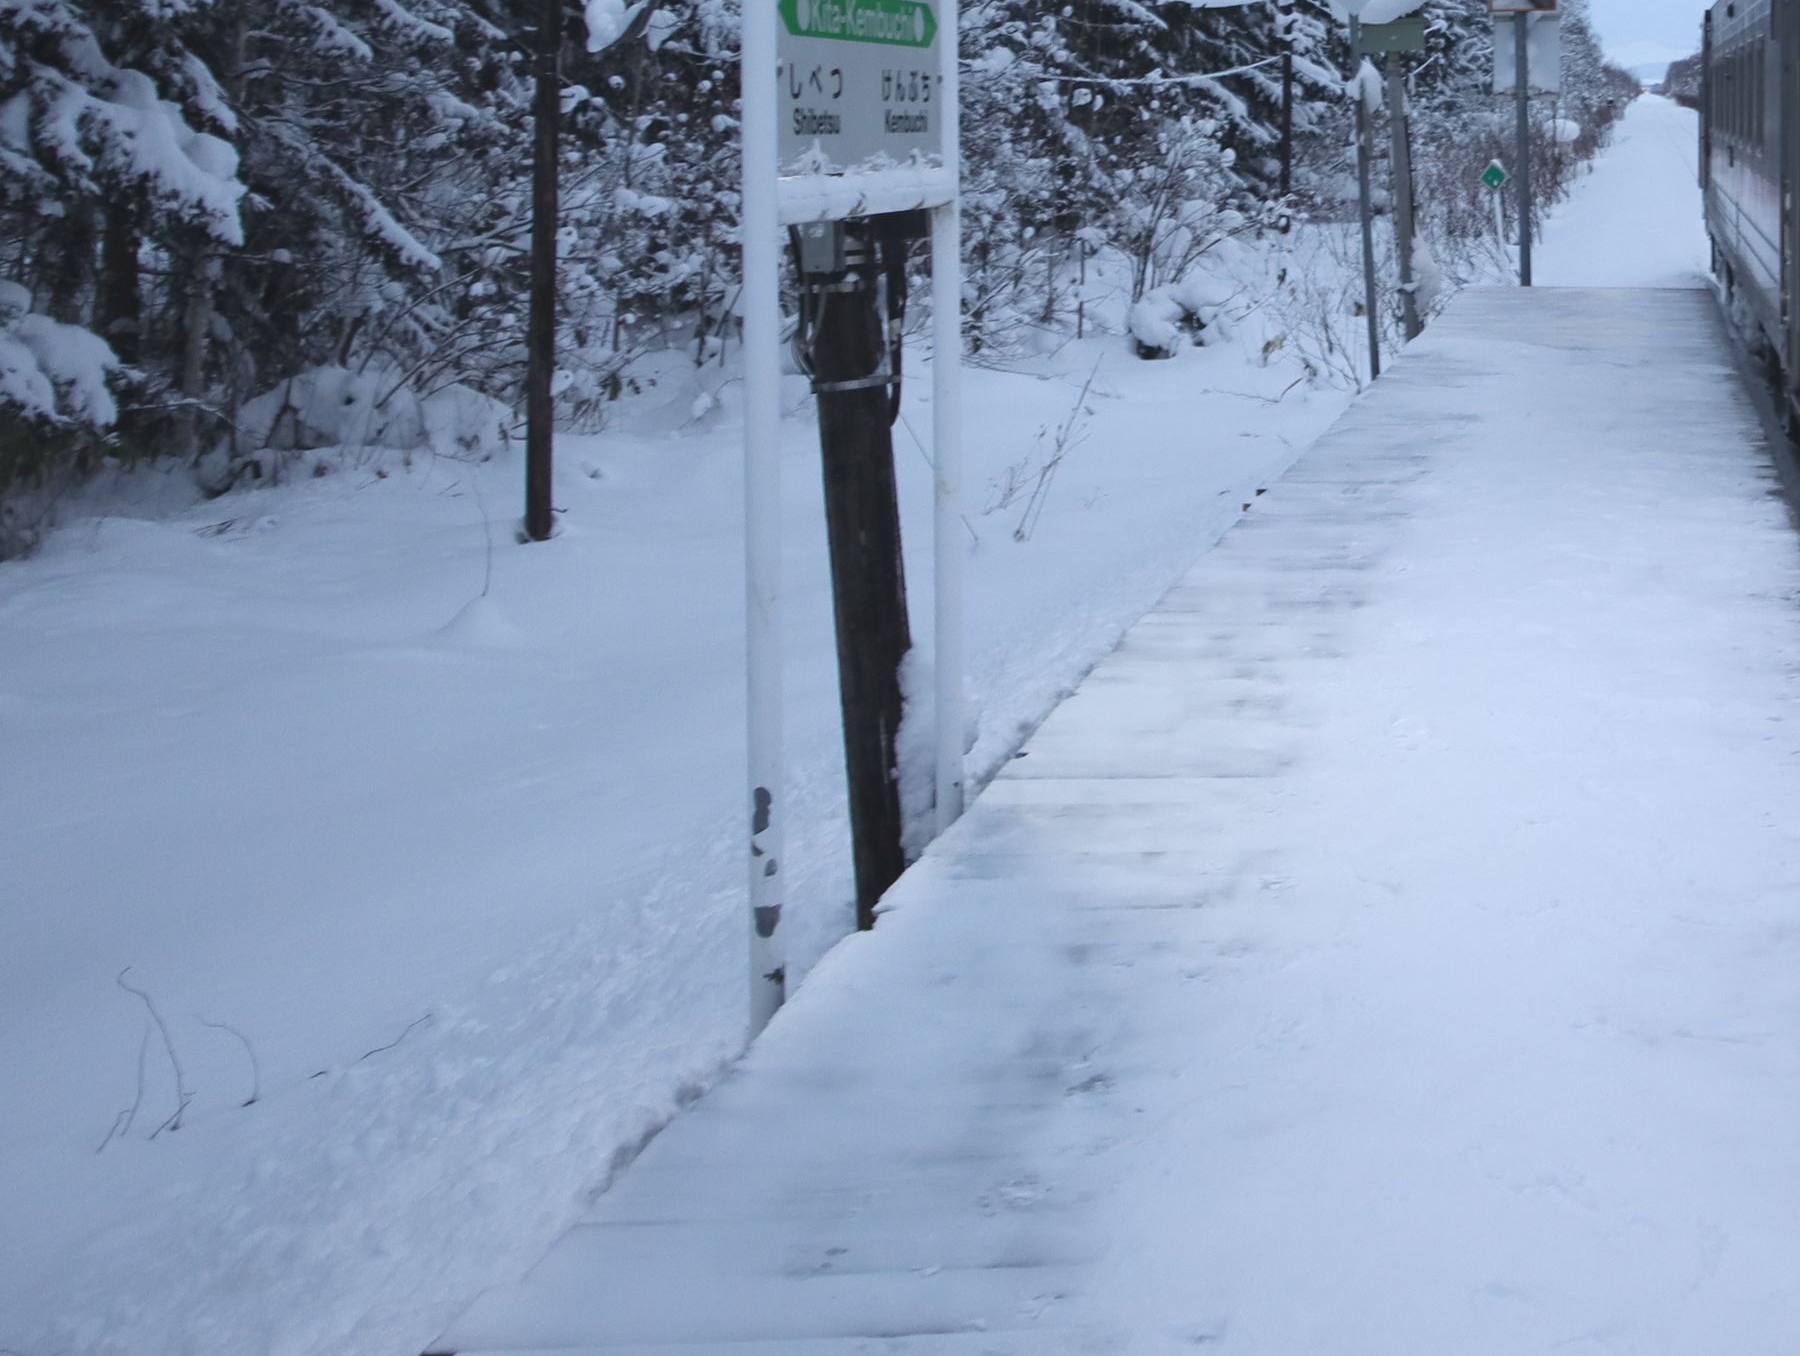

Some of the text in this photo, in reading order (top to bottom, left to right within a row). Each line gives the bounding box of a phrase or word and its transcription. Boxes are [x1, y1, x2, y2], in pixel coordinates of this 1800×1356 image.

[789, 63, 843, 100] しべつ
[882, 69, 931, 103] けんぶち
[793, 107, 841, 136] Shibetsu
[884, 109, 928, 134] Kembuchi
